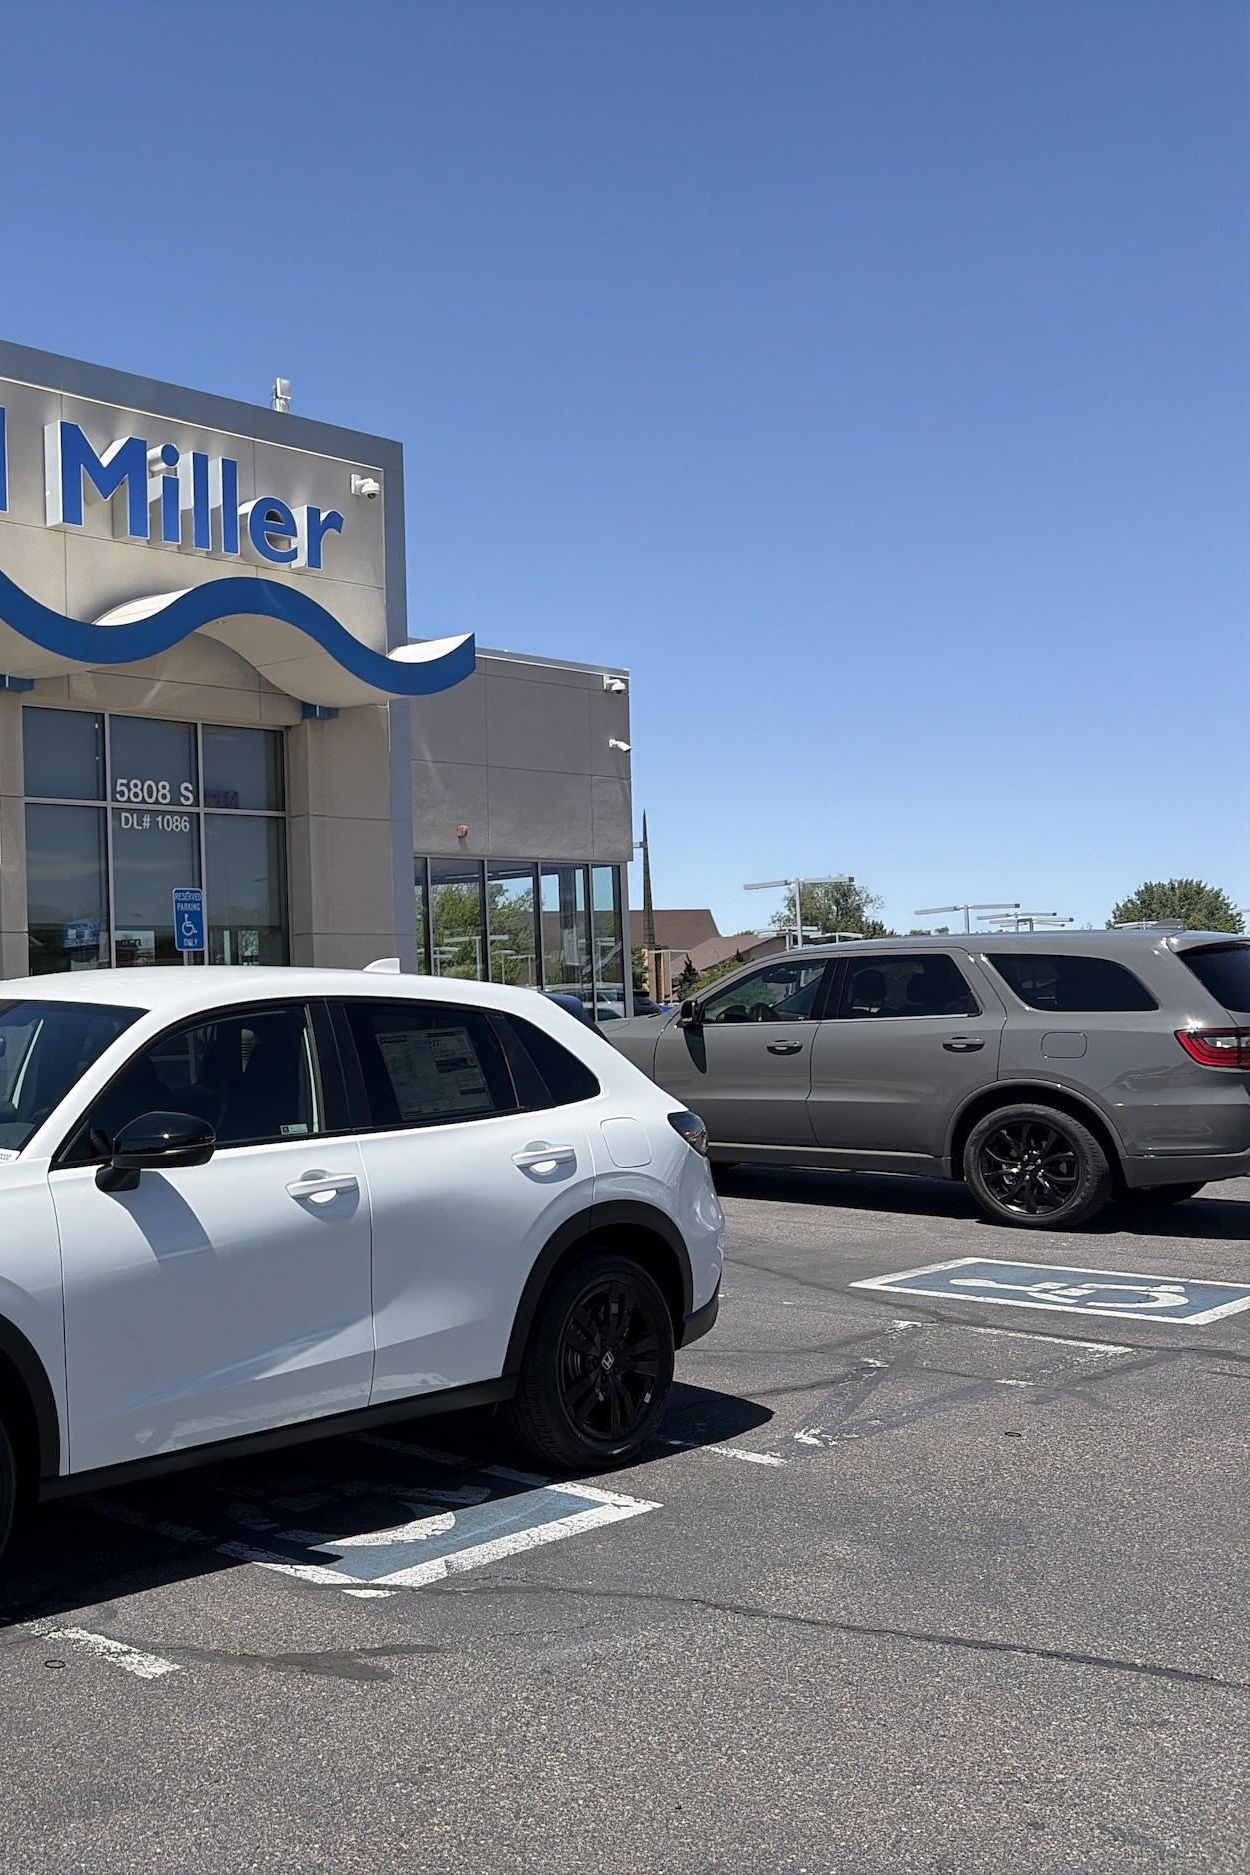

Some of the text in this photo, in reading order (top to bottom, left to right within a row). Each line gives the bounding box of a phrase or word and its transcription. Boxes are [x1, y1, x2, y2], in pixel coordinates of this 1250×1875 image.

[46, 420, 345, 570] Miller
[115, 778, 171, 804] 5808
[180, 782, 194, 806] S
[121, 812, 190, 832] DL# 1086
[174, 891, 202, 901] RESERVED
[176, 902, 201, 911] PARKING
[183, 937, 198, 946] ONLY
